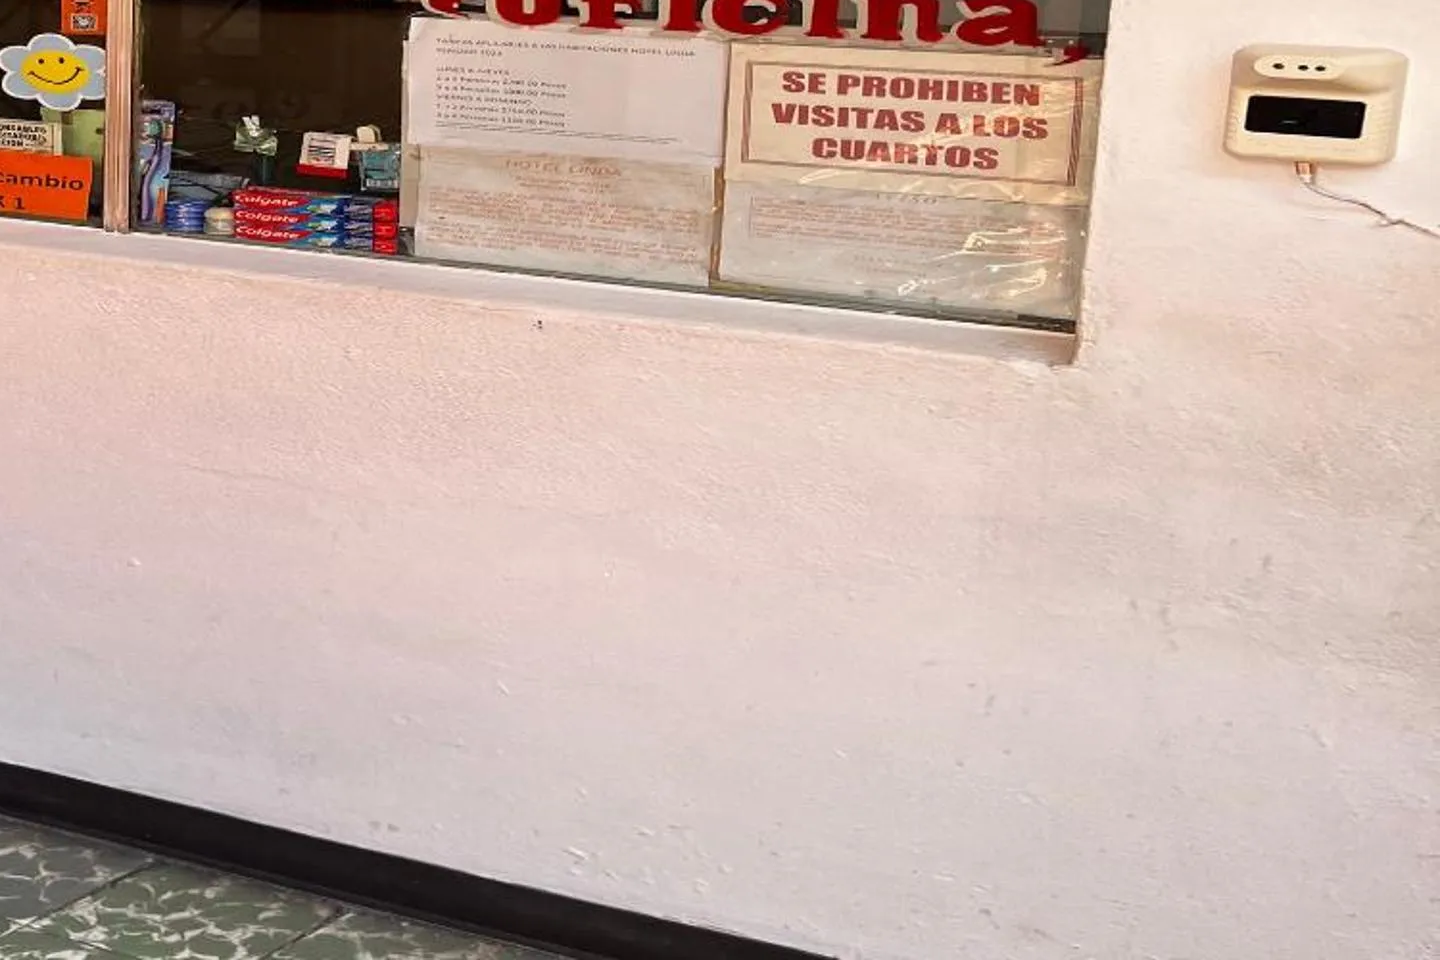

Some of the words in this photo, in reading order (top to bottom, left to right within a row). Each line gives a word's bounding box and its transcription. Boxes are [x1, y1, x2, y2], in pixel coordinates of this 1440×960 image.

[782, 70, 827, 95] SE
[836, 74, 1041, 107] PROHIBEN
[771, 102, 926, 133] VISITAS
[934, 112, 962, 135] A
[973, 115, 1048, 140] LOS
[811, 137, 999, 170] CUARTOS
[14, 196, 26, 210] 1
